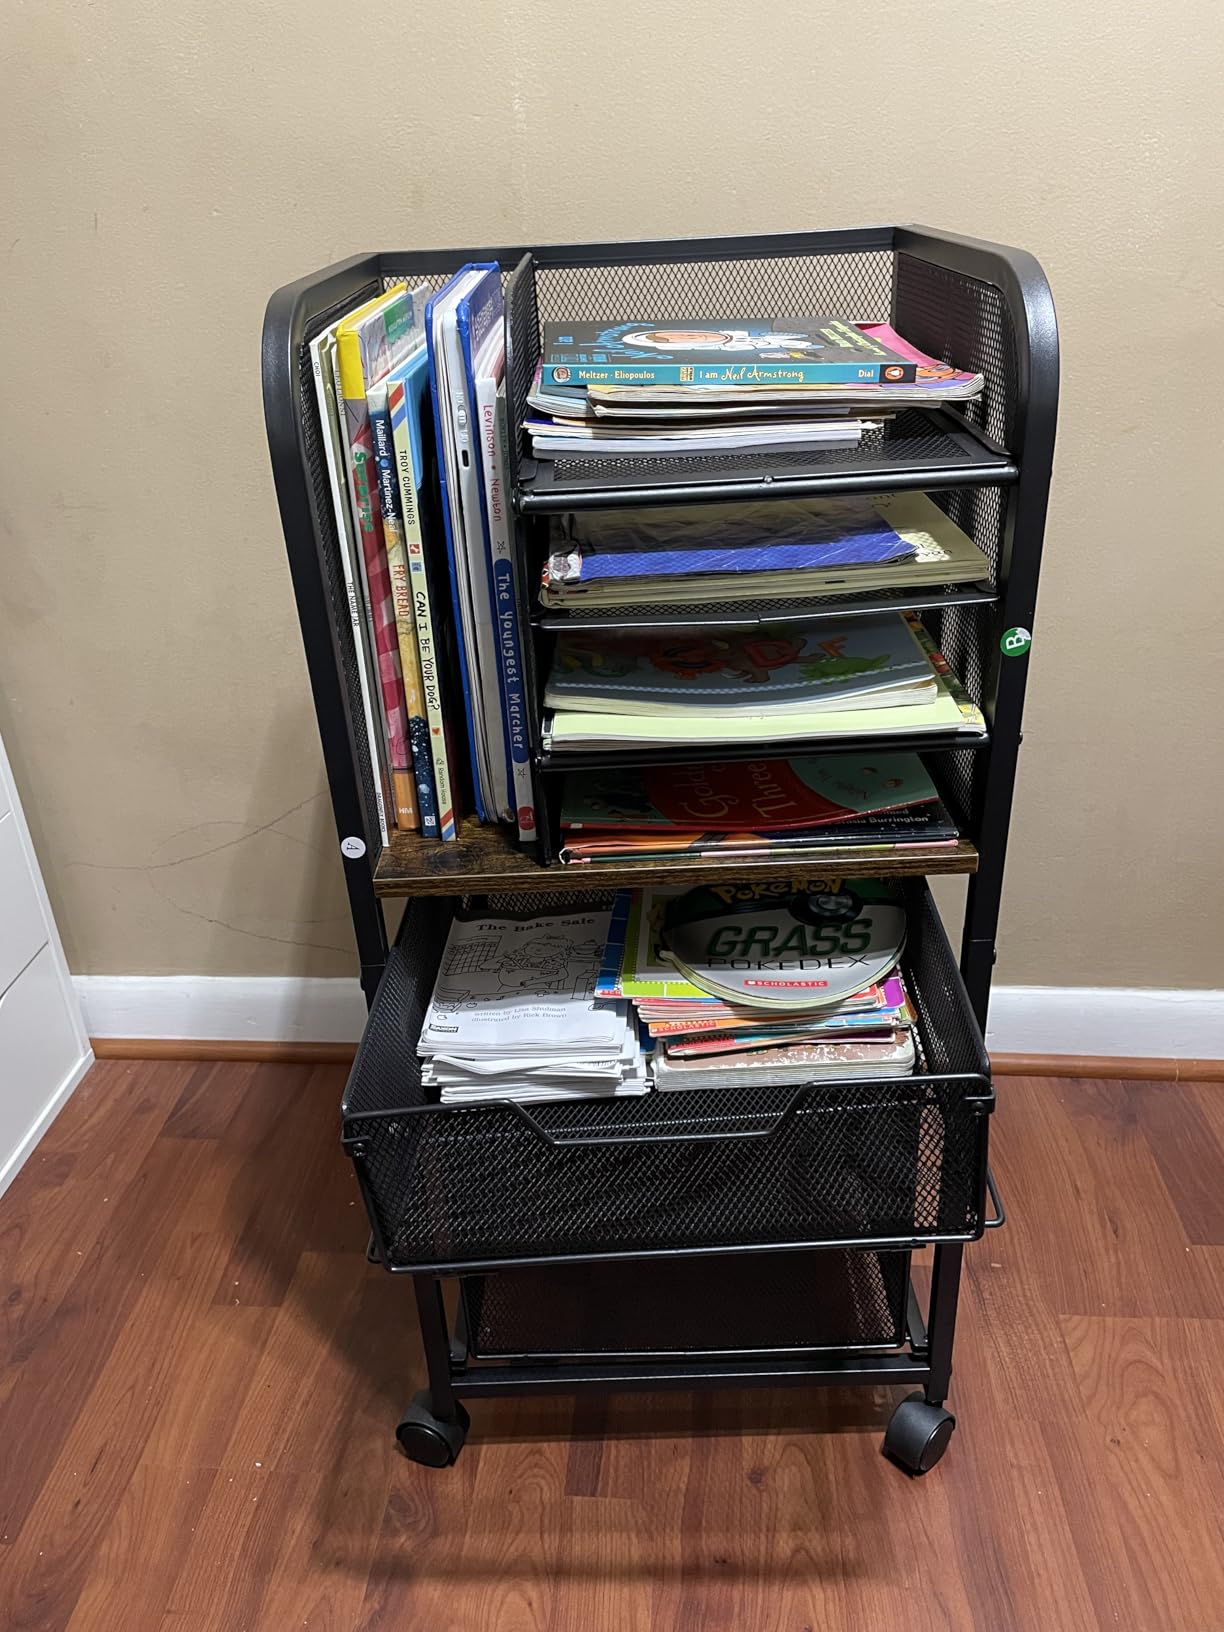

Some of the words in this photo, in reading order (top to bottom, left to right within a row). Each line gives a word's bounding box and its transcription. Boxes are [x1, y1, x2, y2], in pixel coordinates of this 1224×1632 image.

[578, 370, 608, 380] Meltzer
[614, 370, 655, 381] Eliopoulos
[720, 367, 746, 381] Neil
[747, 365, 804, 383] Armstrong
[858, 369, 874, 378] Dial
[375, 419, 388, 456] Maillard
[400, 450, 408, 474] TROY
[482, 404, 496, 457] Levinson
[490, 478, 502, 522] Newton
[381, 469, 398, 532] Martinez-Neal
[402, 477, 416, 526] CUMMINGS
[392, 564, 406, 583] FRY
[395, 586, 410, 617] BREAD
[416, 591, 427, 618] CAN
[418, 622, 428, 631] I
[420, 638, 431, 653] BE
[1005, 634, 1025, 650] B
[422, 657, 435, 682] YOUR
[497, 572, 511, 601] The
[508, 693, 524, 750] Marcher
[868, 816, 929, 825] Burrington
[476, 924, 507, 932] The
[514, 921, 554, 932] Bake
[560, 917, 595, 927] Sale
[707, 919, 874, 957] GRASS
